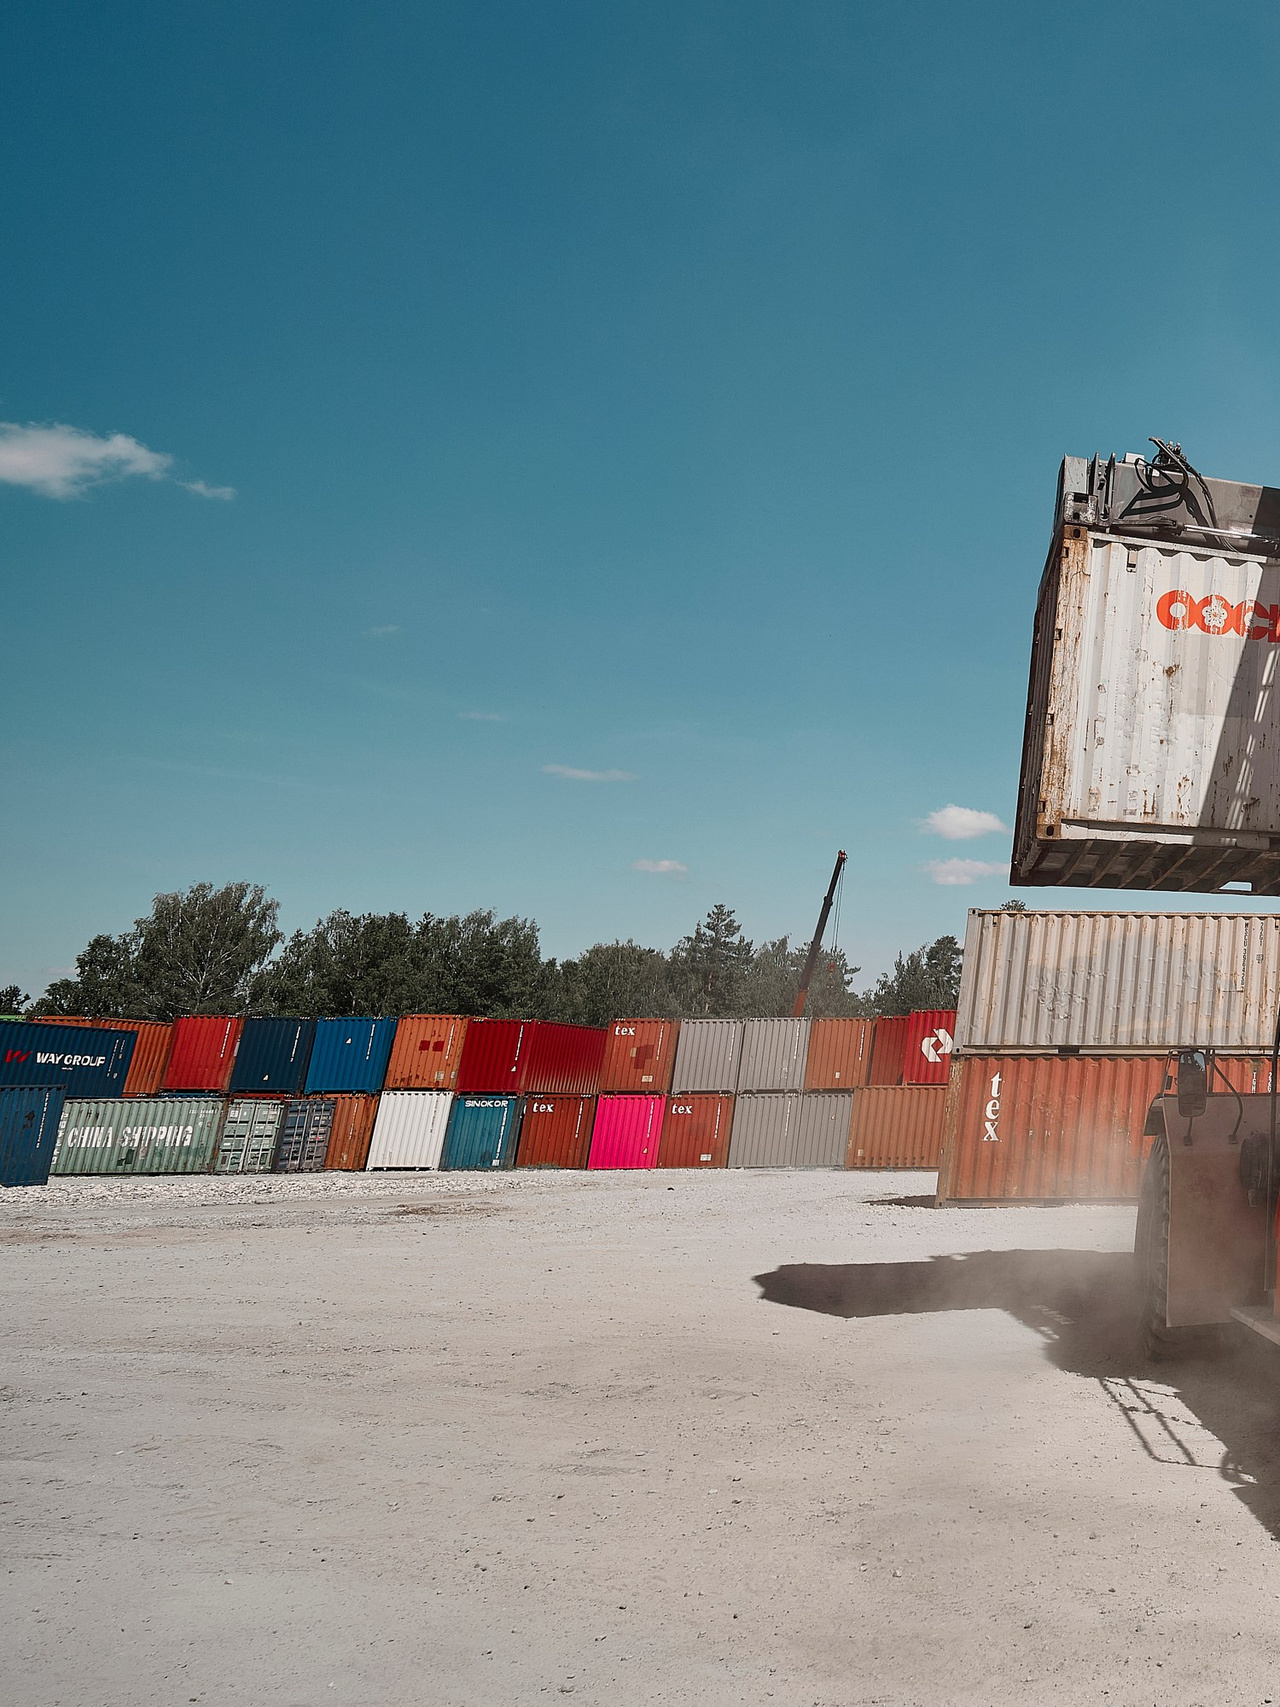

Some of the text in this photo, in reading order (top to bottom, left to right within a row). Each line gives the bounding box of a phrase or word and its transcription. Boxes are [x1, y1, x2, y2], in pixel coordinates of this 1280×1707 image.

[615, 1025, 635, 1036] tex
[36, 1052, 64, 1064] WAY
[533, 1102, 554, 1112] tex
[672, 1103, 693, 1114] tex
[981, 1072, 1002, 1141] tex
[67, 1126, 113, 1148] CHINA
[122, 1125, 194, 1148] SHIPPING
